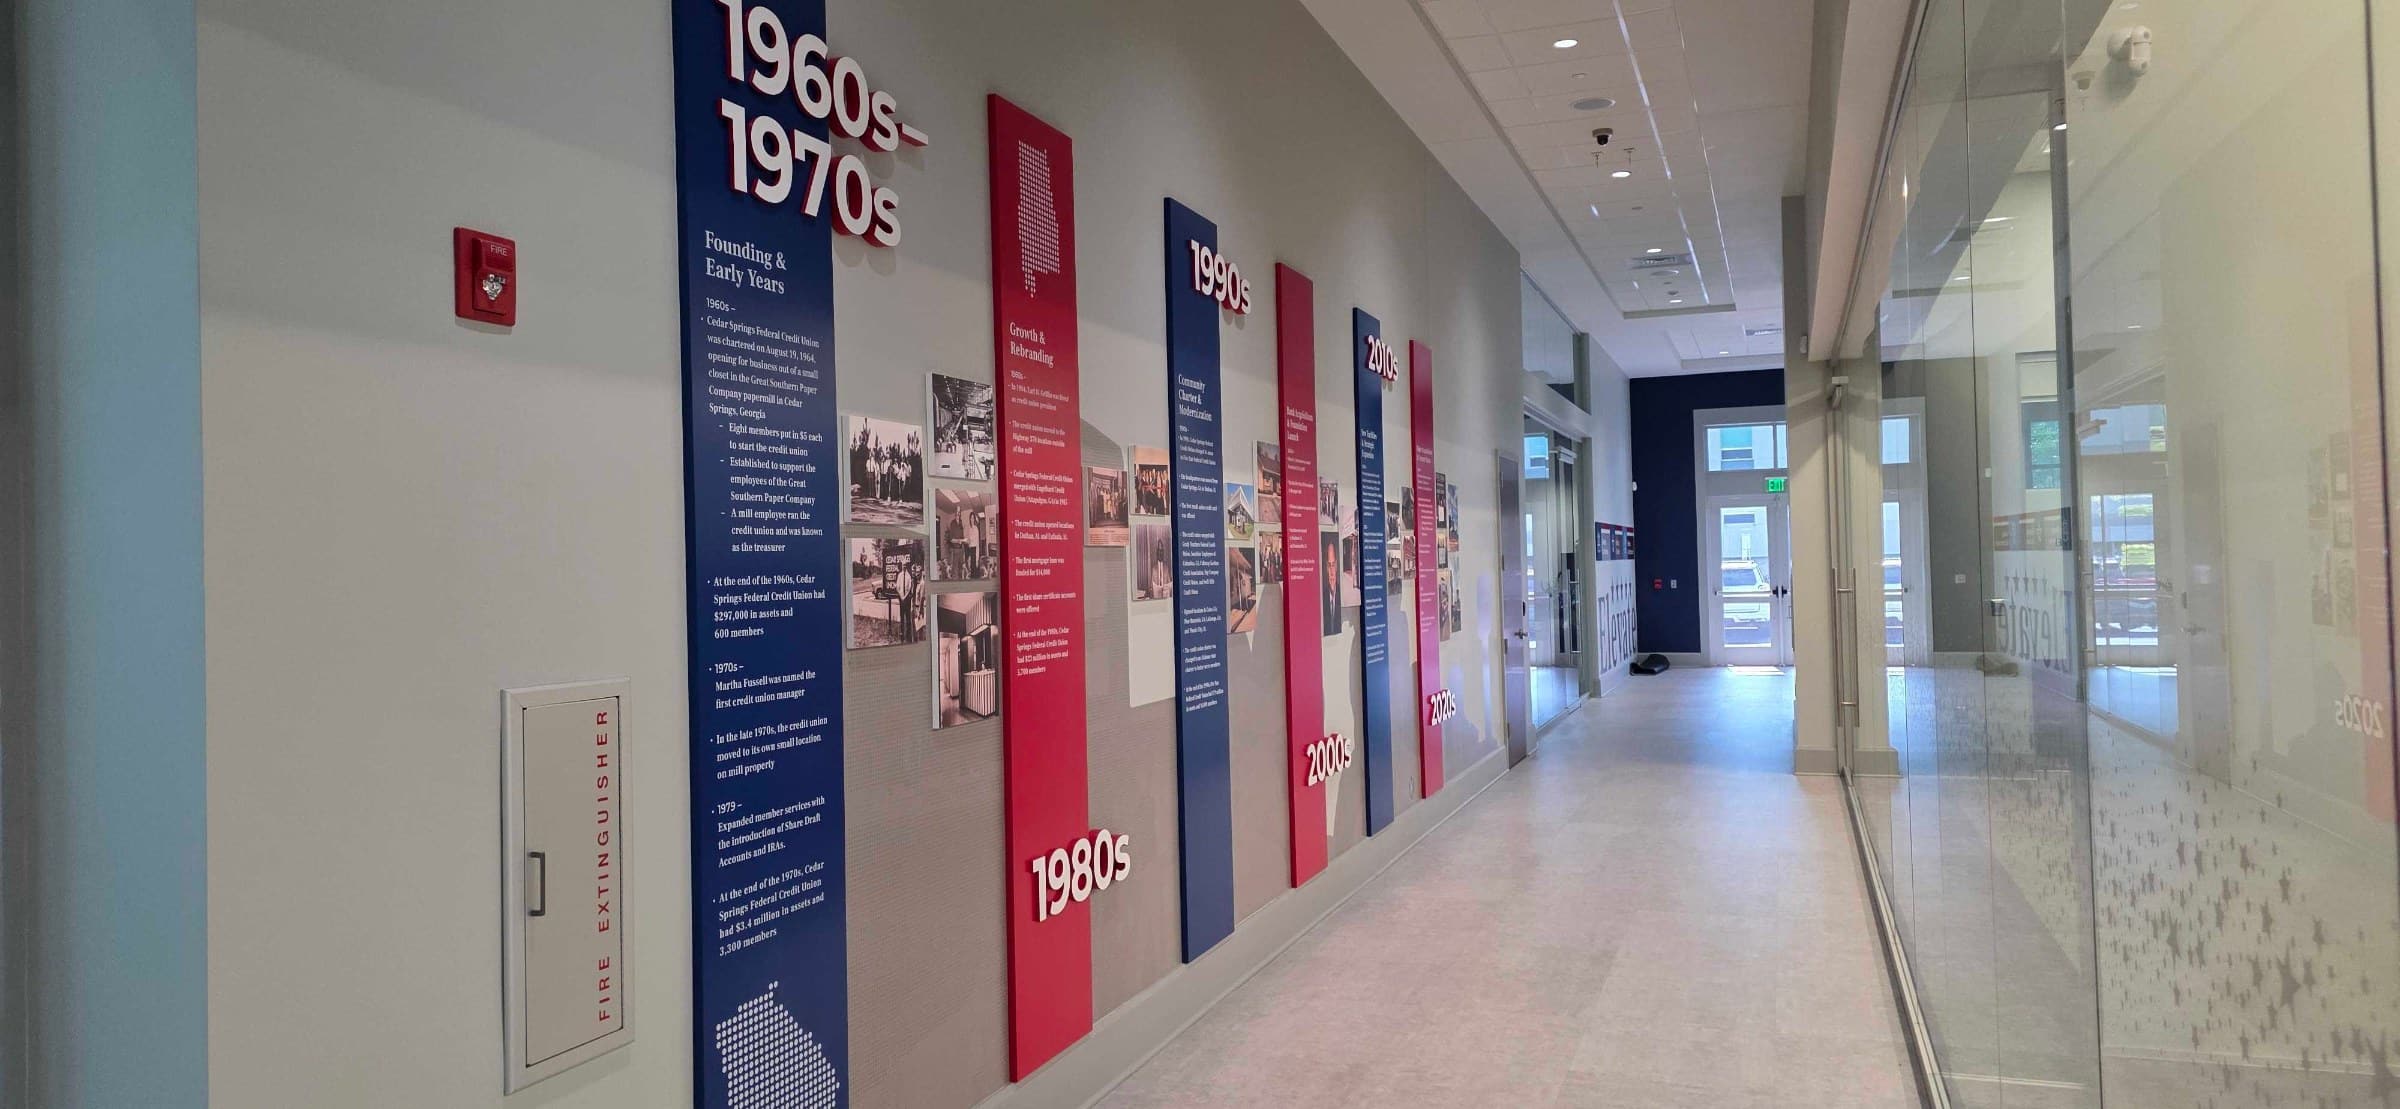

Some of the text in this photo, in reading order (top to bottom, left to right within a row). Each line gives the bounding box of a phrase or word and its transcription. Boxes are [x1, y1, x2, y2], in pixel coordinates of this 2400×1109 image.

[718, 98, 901, 247] 1970s
[491, 245, 507, 256] FIRE
[705, 230, 787, 270] Founding &
[706, 258, 784, 294] Early Years
[1190, 239, 1250, 314] 1990s
[706, 297, 730, 312] 1960s
[707, 316, 728, 328] Cedar
[730, 321, 755, 335] Springs
[756, 326, 780, 339] Federal
[782, 332, 800, 344] Credit
[1010, 322, 1045, 344] Growth &
[708, 335, 720, 344] was
[722, 336, 755, 350] chartered
[766, 346, 788, 357] August
[790, 350, 798, 360] 19,
[1010, 341, 1054, 368] Rebranding
[1367, 334, 1398, 381] 2010s
[708, 353, 777, 371] opening for business
[708, 368, 817, 395] closet Great Southern Paper
[708, 386, 741, 400] Company
[784, 397, 802, 407] Cedar
[740, 407, 766, 420] Georgia
[729, 423, 822, 442] Eight members put $5 each
[730, 440, 808, 456] to start credit union
[730, 457, 815, 473] Established support the
[731, 475, 806, 487] employees Great
[731, 491, 815, 506] Southern Paper Company
[731, 508, 737, 517] A
[738, 509, 752, 517] mill
[754, 510, 786, 520] employee
[800, 511, 810, 519] the
[732, 526, 752, 534] credit
[754, 526, 774, 535] union
[776, 526, 787, 535] and
[802, 527, 822, 536] known
[742, 542, 752, 551] the
[714, 577, 722, 586] At
[724, 576, 735, 586] the
[738, 576, 750, 585] end
[796, 574, 815, 583] Cedar
[714, 589, 825, 606] Springs Federal Credit Union had
[714, 607, 793, 621] $297,000 in assets and
[715, 627, 764, 638] 600 members
[1598, 593, 1637, 675] Elevate
[715, 662, 738, 673] 1970s
[715, 670, 815, 691] Martha Fussell was named the
[716, 689, 805, 709] first credit union manager
[1430, 689, 1456, 726] 2020s
[716, 735, 724, 744] In
[726, 732, 738, 742] the
[740, 730, 752, 739] late
[777, 723, 788, 732] the
[790, 720, 808, 730] credit
[810, 717, 828, 726] union
[717, 734, 821, 761] moved own small location
[717, 760, 775, 779] on mill property
[1306, 733, 1351, 787] 2000s
[717, 802, 735, 814] 1979
[718, 796, 825, 832] Expanded member services with
[718, 813, 820, 850] the introduction of Share Draft
[596, 711, 610, 1021] FIRE EXTINGUISHER
[719, 851, 752, 867] Accounts
[754, 845, 766, 857] and
[719, 893, 728, 903] At
[730, 889, 742, 899] the
[744, 882, 758, 894] end
[805, 862, 824, 874] Cedar
[1030, 829, 1130, 922] 1980s
[719, 880, 821, 921] Springs Federal Credit Union
[720, 892, 824, 938] had $3.4 million in assets and
[720, 929, 776, 956] 3,300 members
